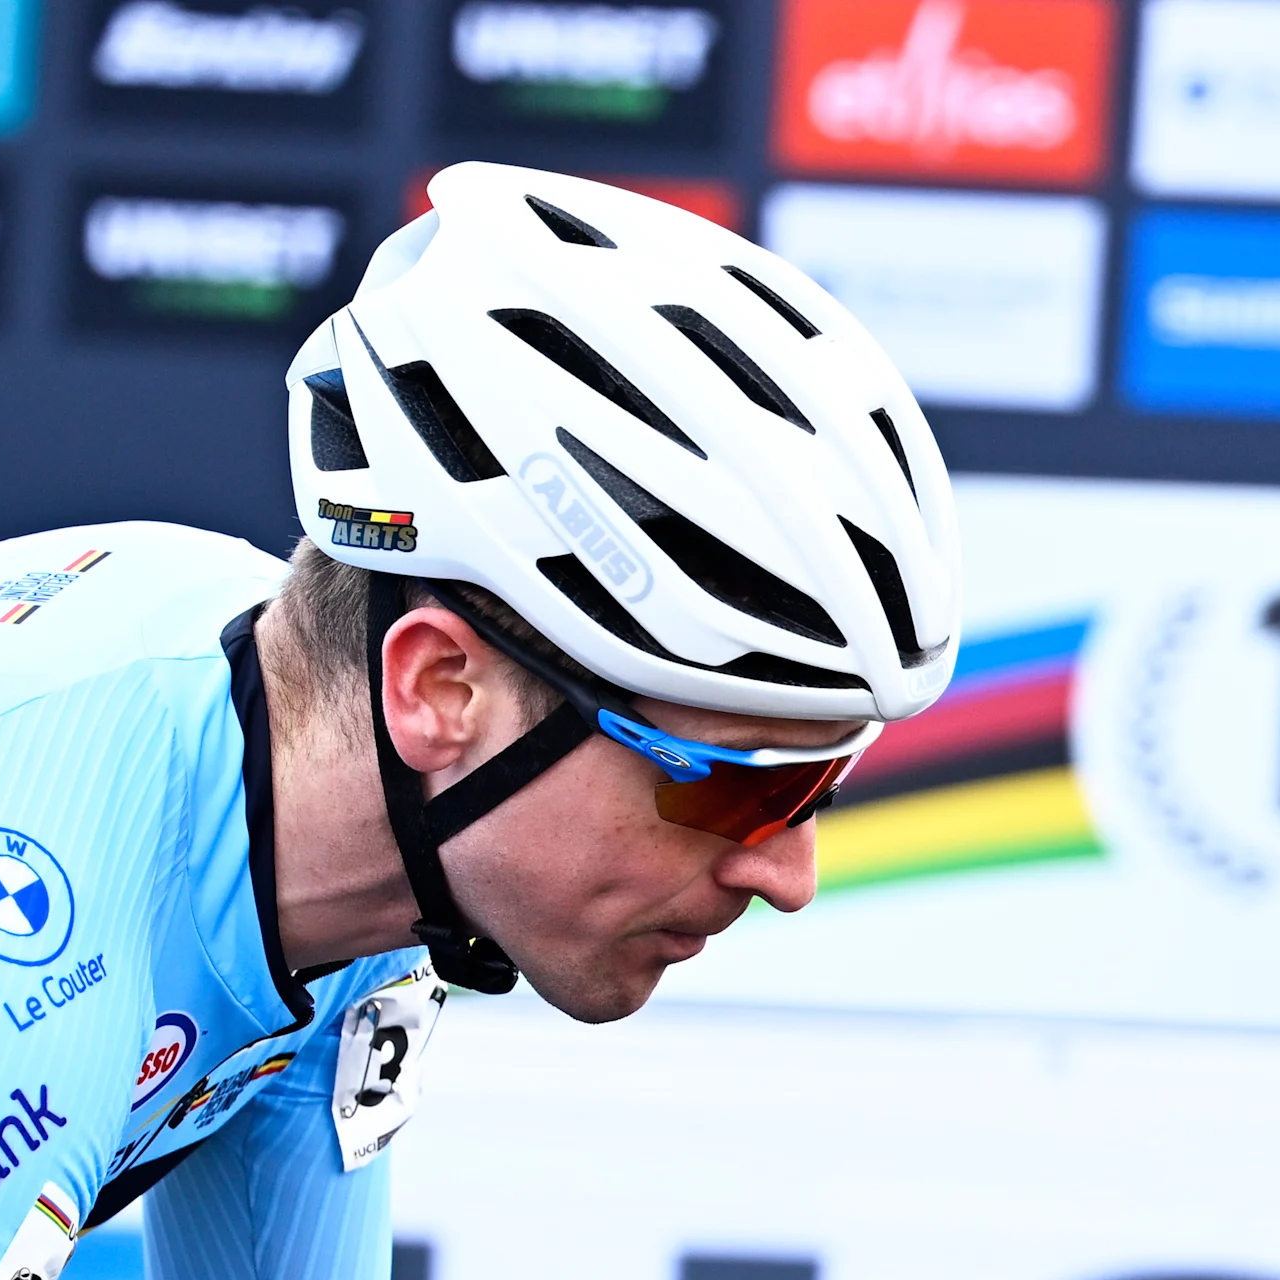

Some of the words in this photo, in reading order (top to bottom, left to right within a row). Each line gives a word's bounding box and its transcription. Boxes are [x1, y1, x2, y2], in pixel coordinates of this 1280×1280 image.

[332, 520, 417, 551] AERTS
[532, 474, 639, 590] ABUS
[3, 990, 47, 1032] Le
[41, 953, 108, 1010] Couter
